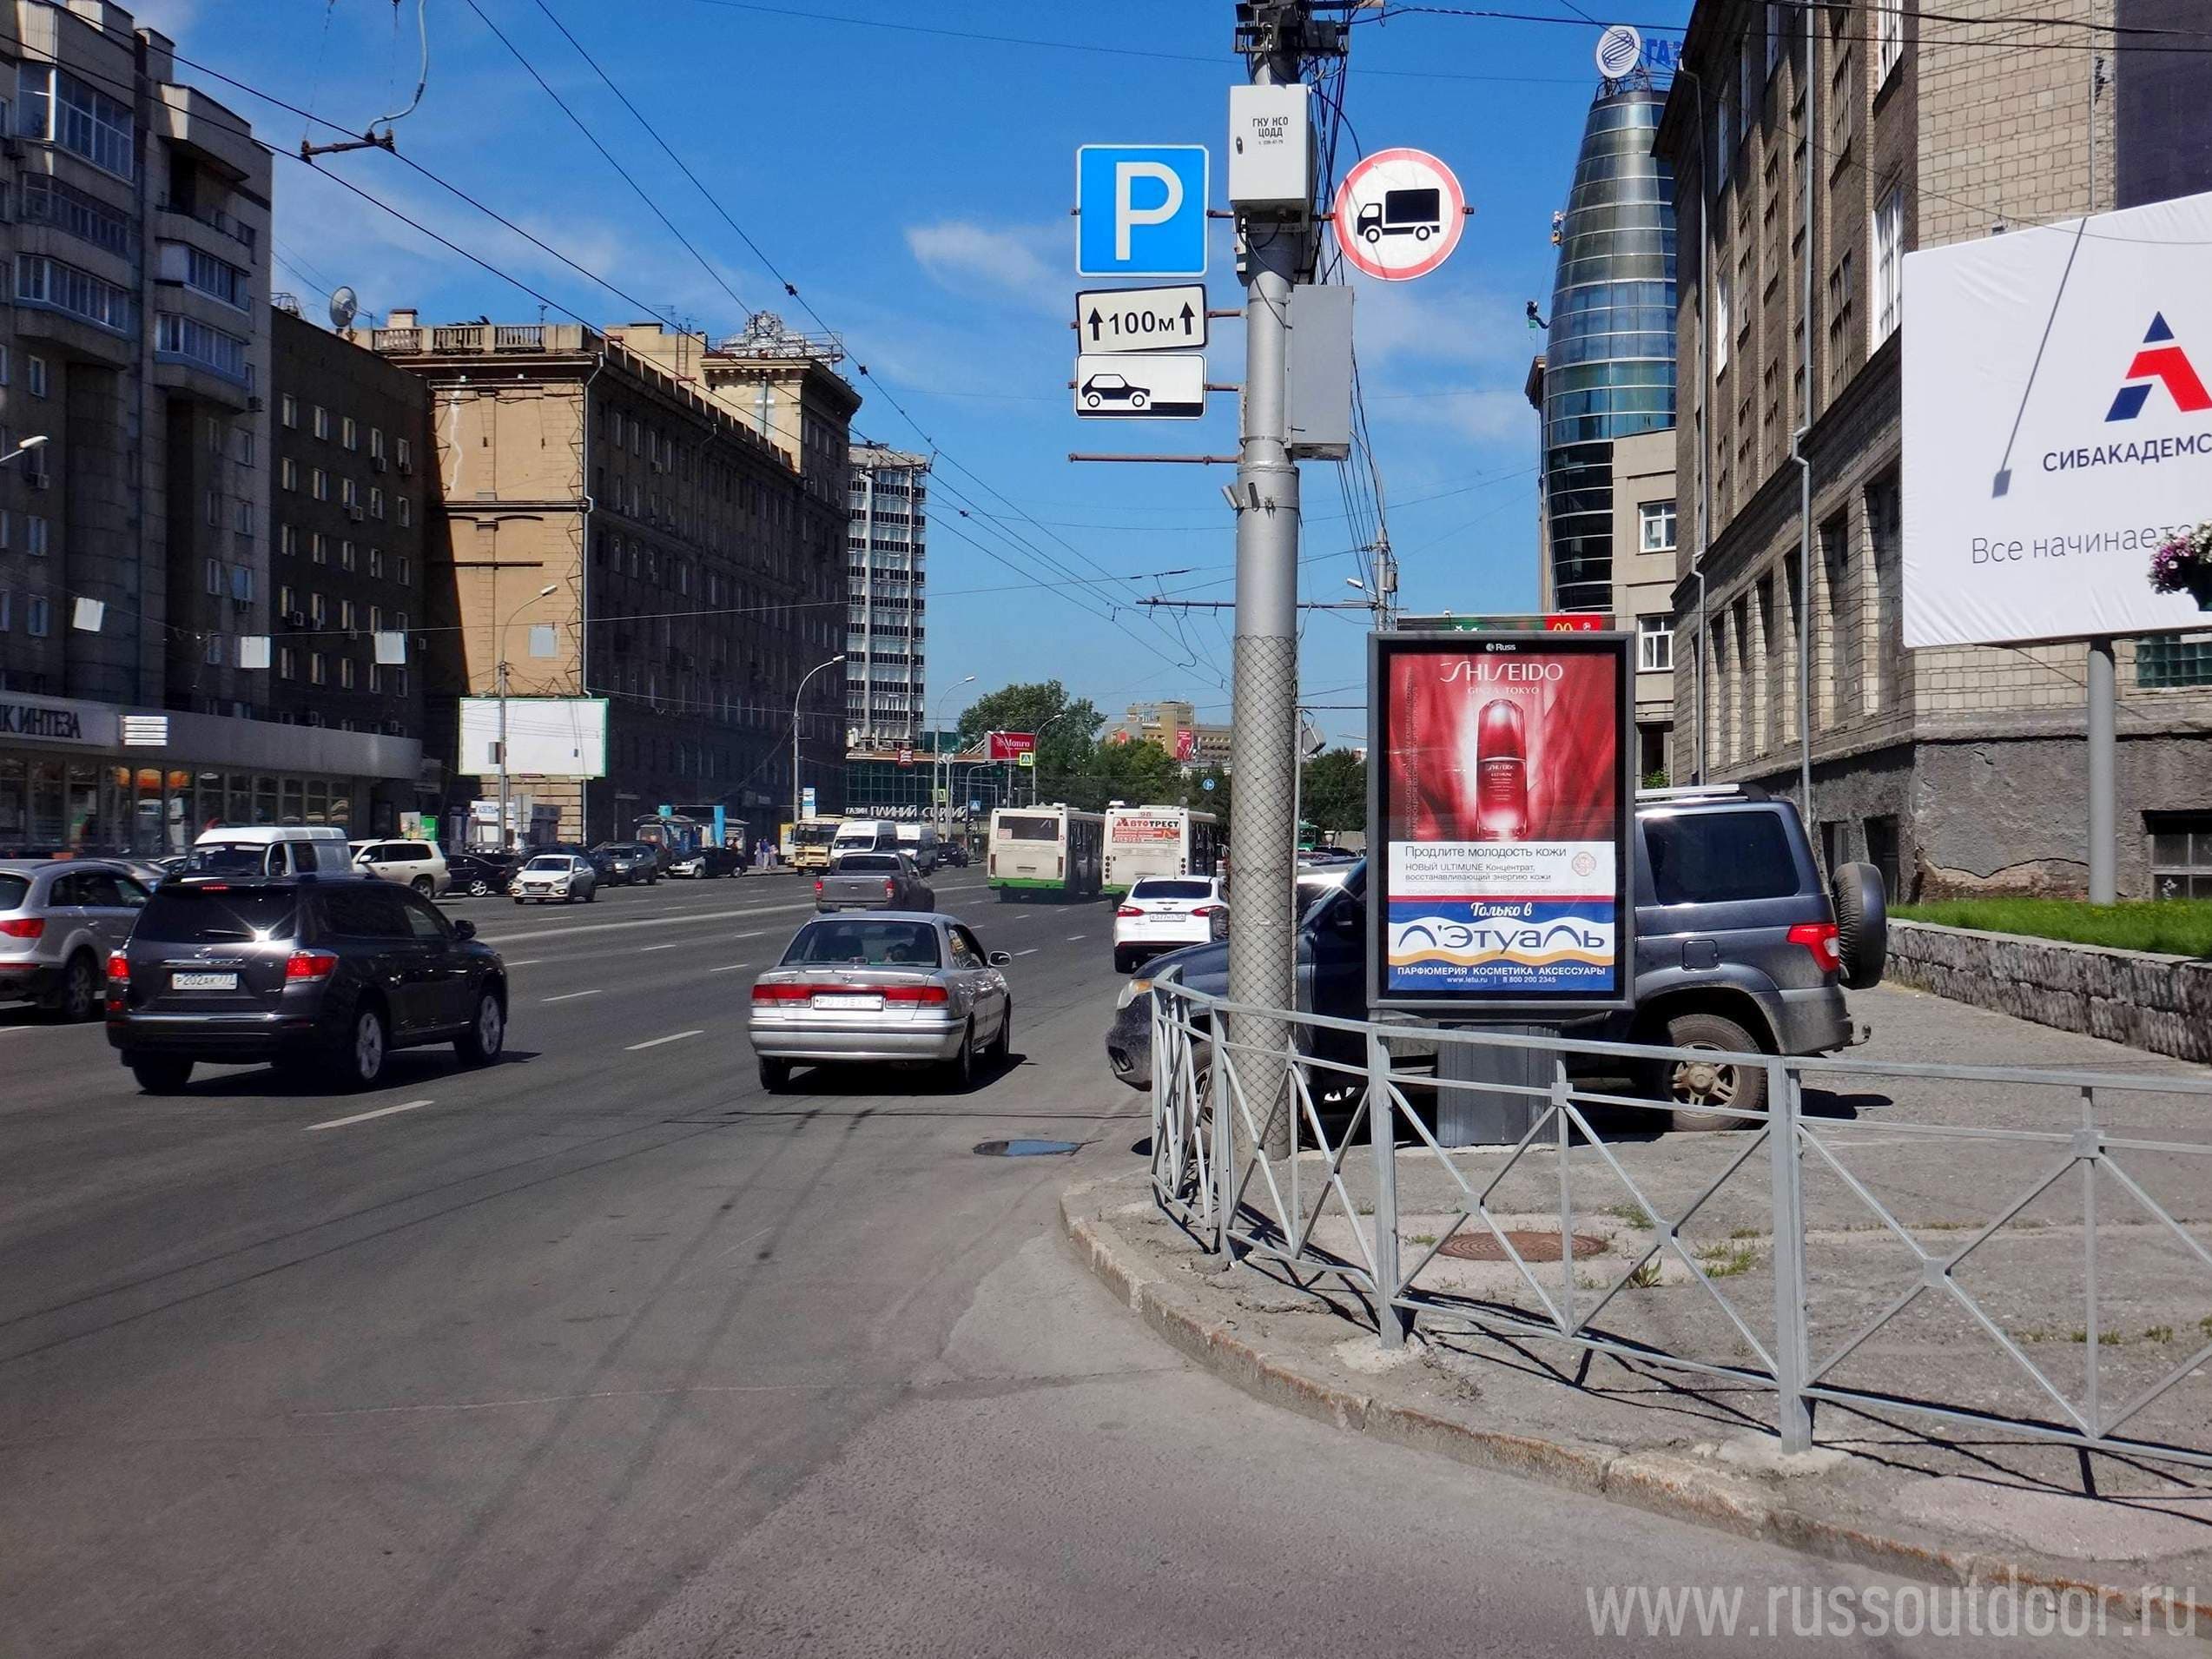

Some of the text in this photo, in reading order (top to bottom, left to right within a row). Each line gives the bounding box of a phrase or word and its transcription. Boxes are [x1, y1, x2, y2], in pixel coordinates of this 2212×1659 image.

[1252, 116, 1289, 128] ГКУ НСО
[1258, 127, 1284, 138] ЦОДД
[1115, 162, 1184, 261] P
[2043, 433, 2212, 472] СИБАКАДЕМС
[1972, 537, 2024, 565] Все
[1496, 643, 1516, 651] Russ
[1440, 660, 1563, 683] SHISEIDO
[1506, 686, 1540, 695] TOKYO
[19, 706, 82, 739] ИНТЕЗА
[1405, 845, 1567, 857] Продлите молодость кожи
[1405, 862, 1438, 871] НОВЫЙ
[1440, 863, 1483, 871] ULTIMUNE
[1405, 874, 1491, 882] восстанавливающий
[1493, 874, 1529, 882] энергию
[1470, 902, 1533, 917] Только в
[1397, 967, 1606, 975] ПАРФЮМЕРИЯ КОСМЕТИКА АКСЕССУАРЫ
